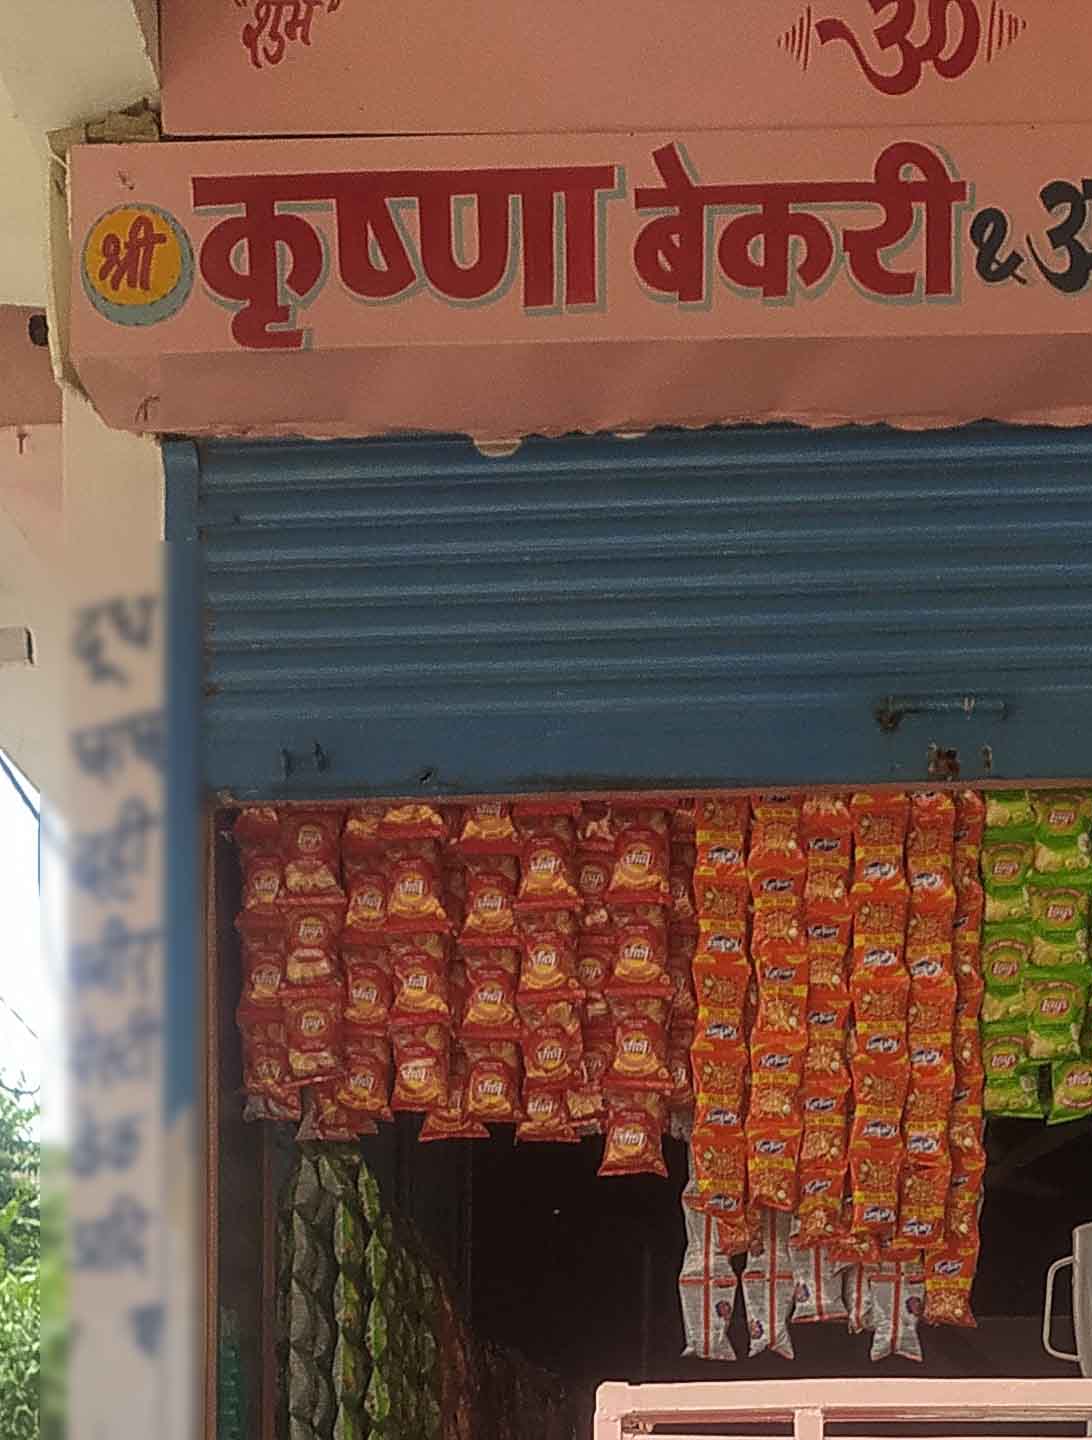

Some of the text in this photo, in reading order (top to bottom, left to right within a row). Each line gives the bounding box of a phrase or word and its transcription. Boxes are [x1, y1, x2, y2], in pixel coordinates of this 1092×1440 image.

[98, 214, 168, 292] श्री
[191, 164, 618, 349] कृष्णा
[632, 141, 970, 304] बेकरी
[969, 207, 1028, 285] &
